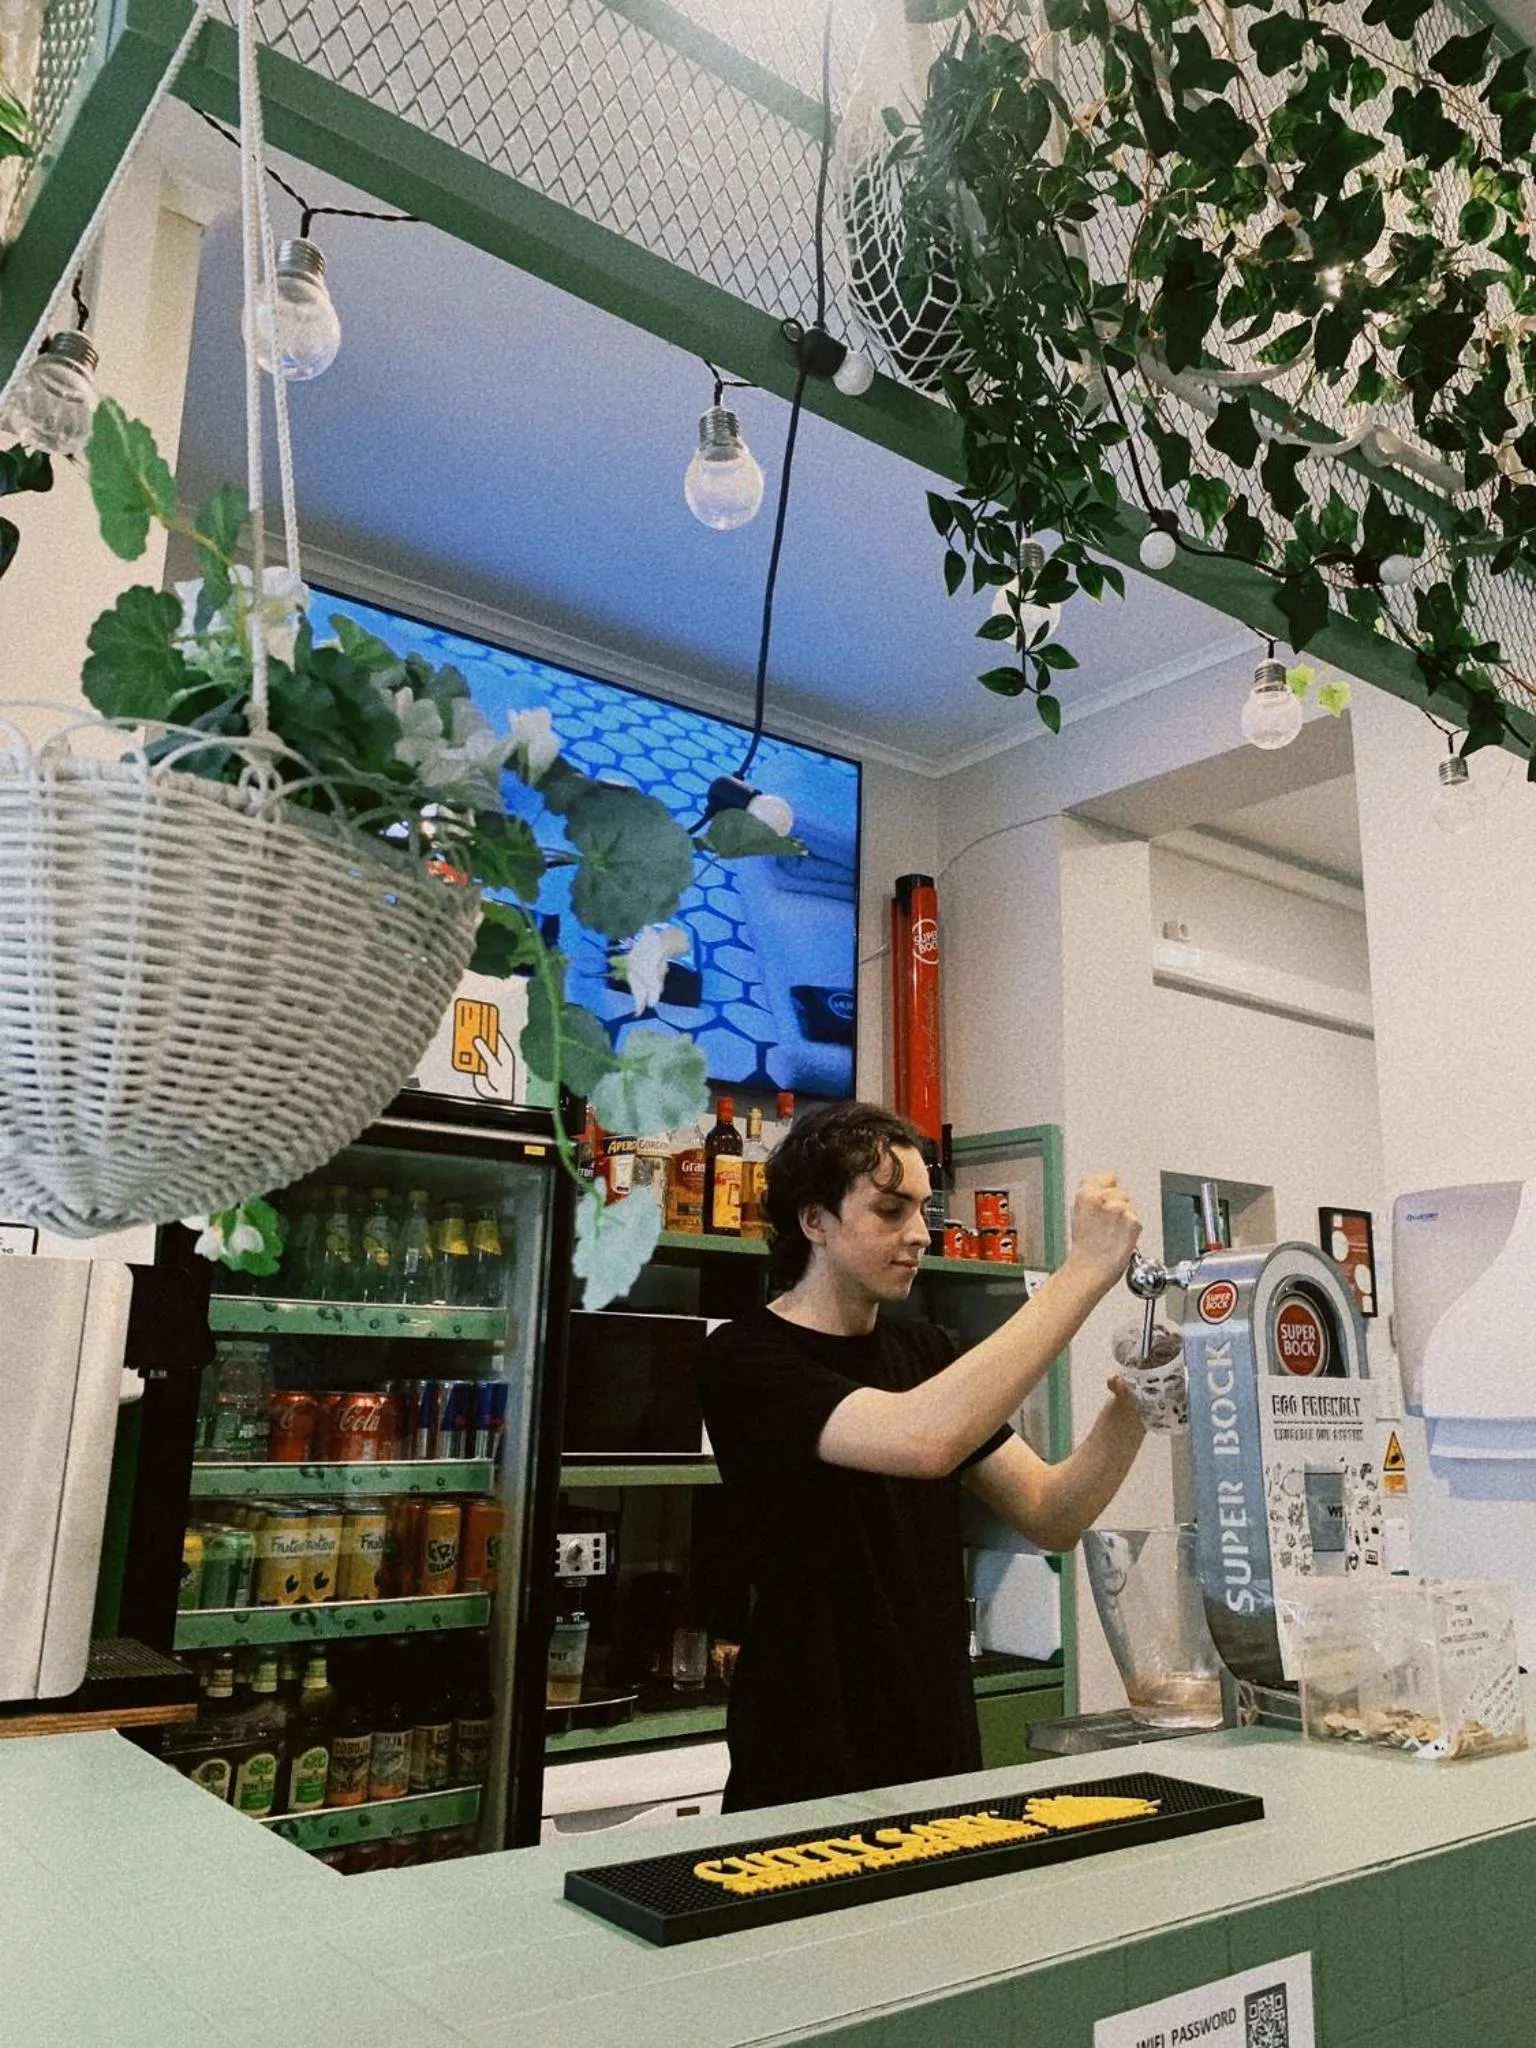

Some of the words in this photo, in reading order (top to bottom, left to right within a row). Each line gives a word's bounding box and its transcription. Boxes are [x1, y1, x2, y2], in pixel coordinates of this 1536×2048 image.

[913, 930, 938, 946] SUPE
[1205, 1299, 1228, 1310] BOCK
[1206, 1292, 1231, 1304] SUPER
[1280, 1323, 1316, 1341] SUPER
[1283, 1340, 1316, 1357] BOCK
[1206, 1340, 1240, 1455] BOCK
[1272, 1394, 1298, 1416] ECO
[1302, 1395, 1361, 1417] FRIENDLY
[1218, 1479, 1254, 1613] SUPER
[1171, 2007, 1237, 2047] PASSWORD
